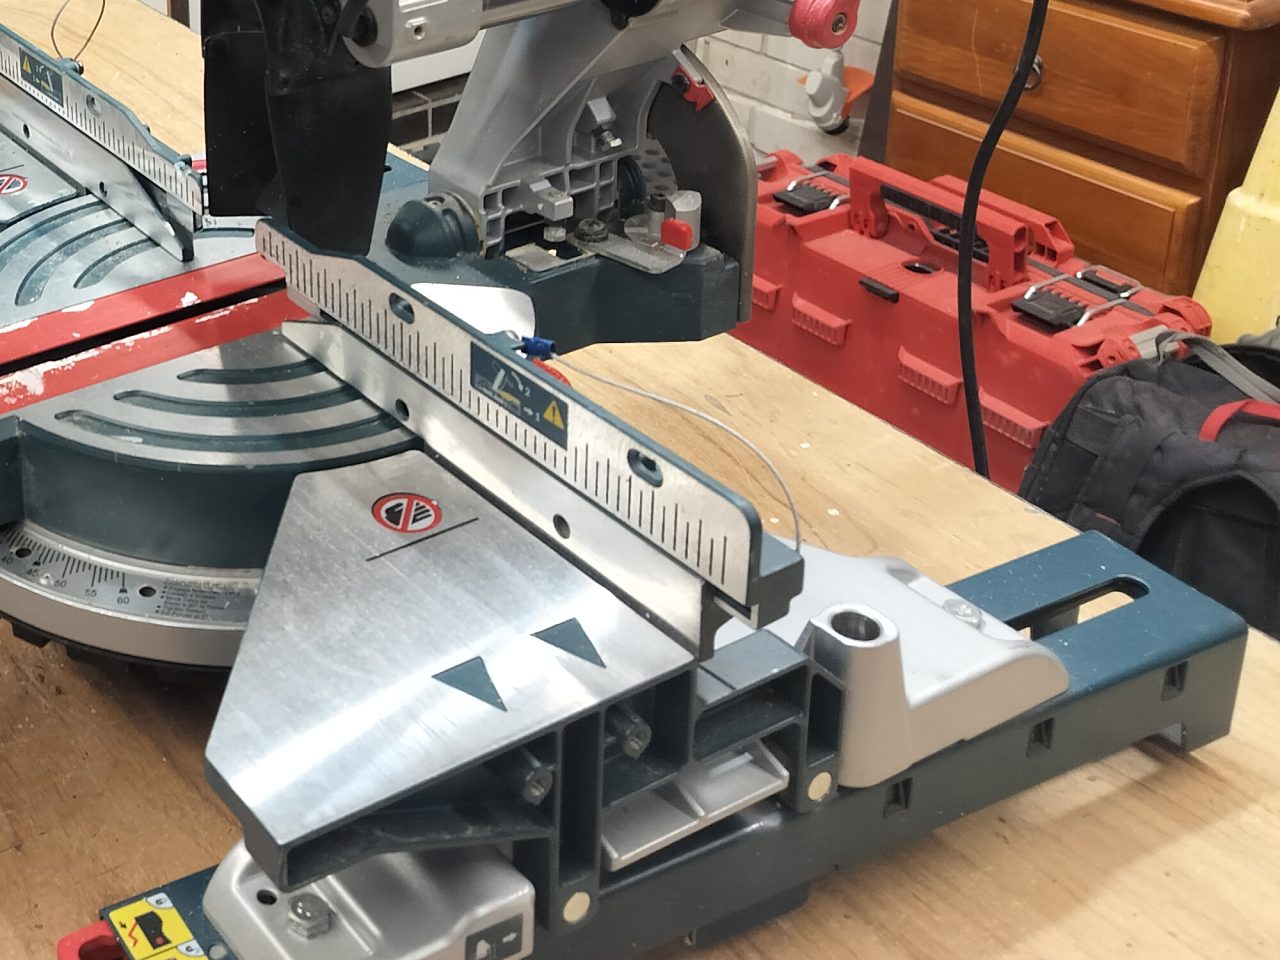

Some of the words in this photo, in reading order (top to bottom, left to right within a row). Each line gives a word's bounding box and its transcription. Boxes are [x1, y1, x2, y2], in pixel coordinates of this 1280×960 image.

[54, 580, 67, 588] 50
[84, 589, 97, 597] 55
[117, 597, 130, 605] 60
